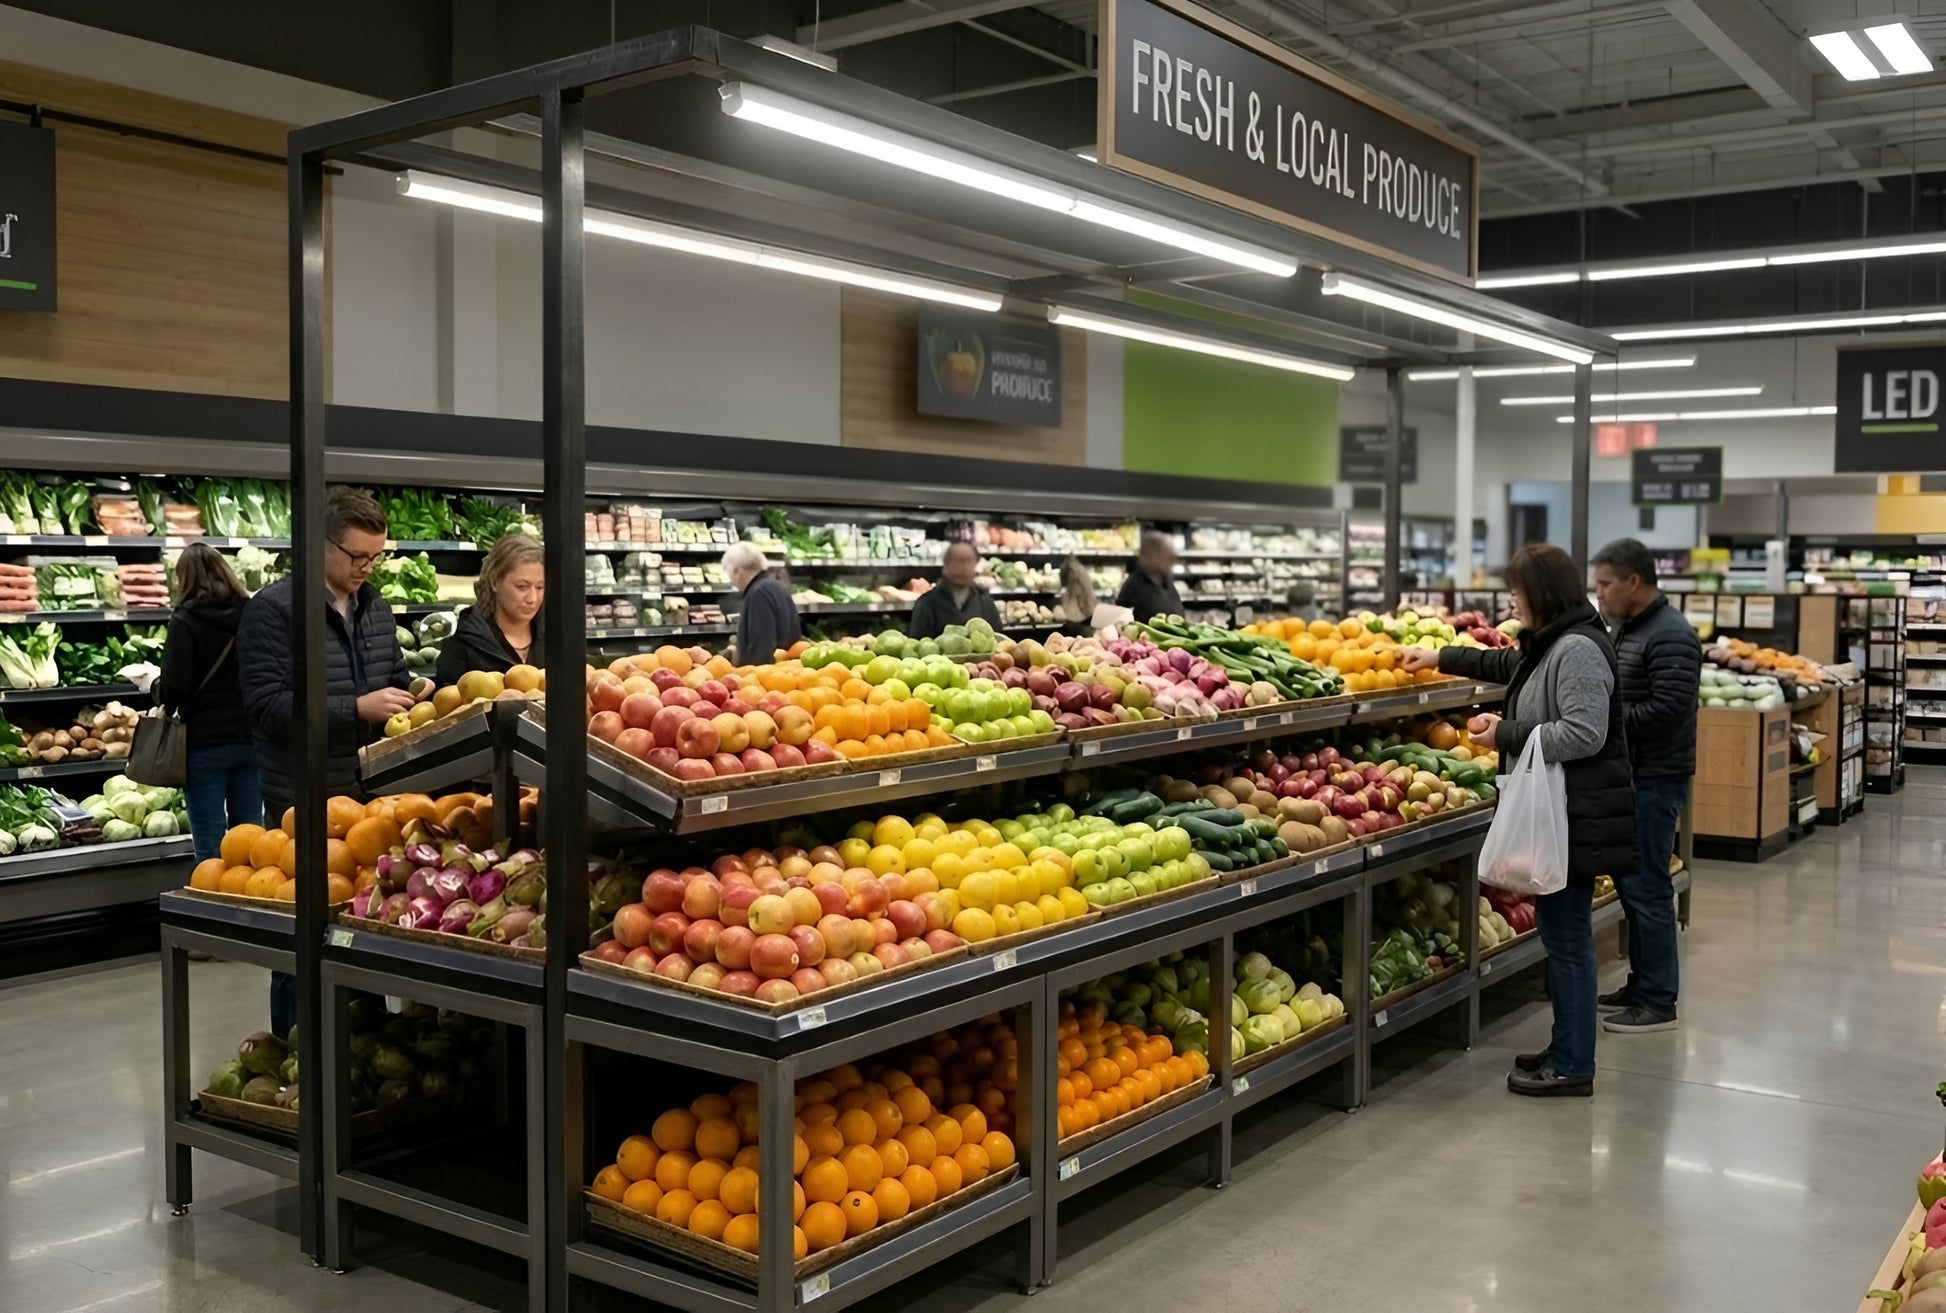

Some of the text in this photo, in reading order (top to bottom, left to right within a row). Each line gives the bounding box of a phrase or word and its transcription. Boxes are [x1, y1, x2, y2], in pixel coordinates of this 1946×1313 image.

[1132, 38, 1462, 240] FRESH & LOCAL PRODUCE
[1861, 369, 1940, 420] LED
